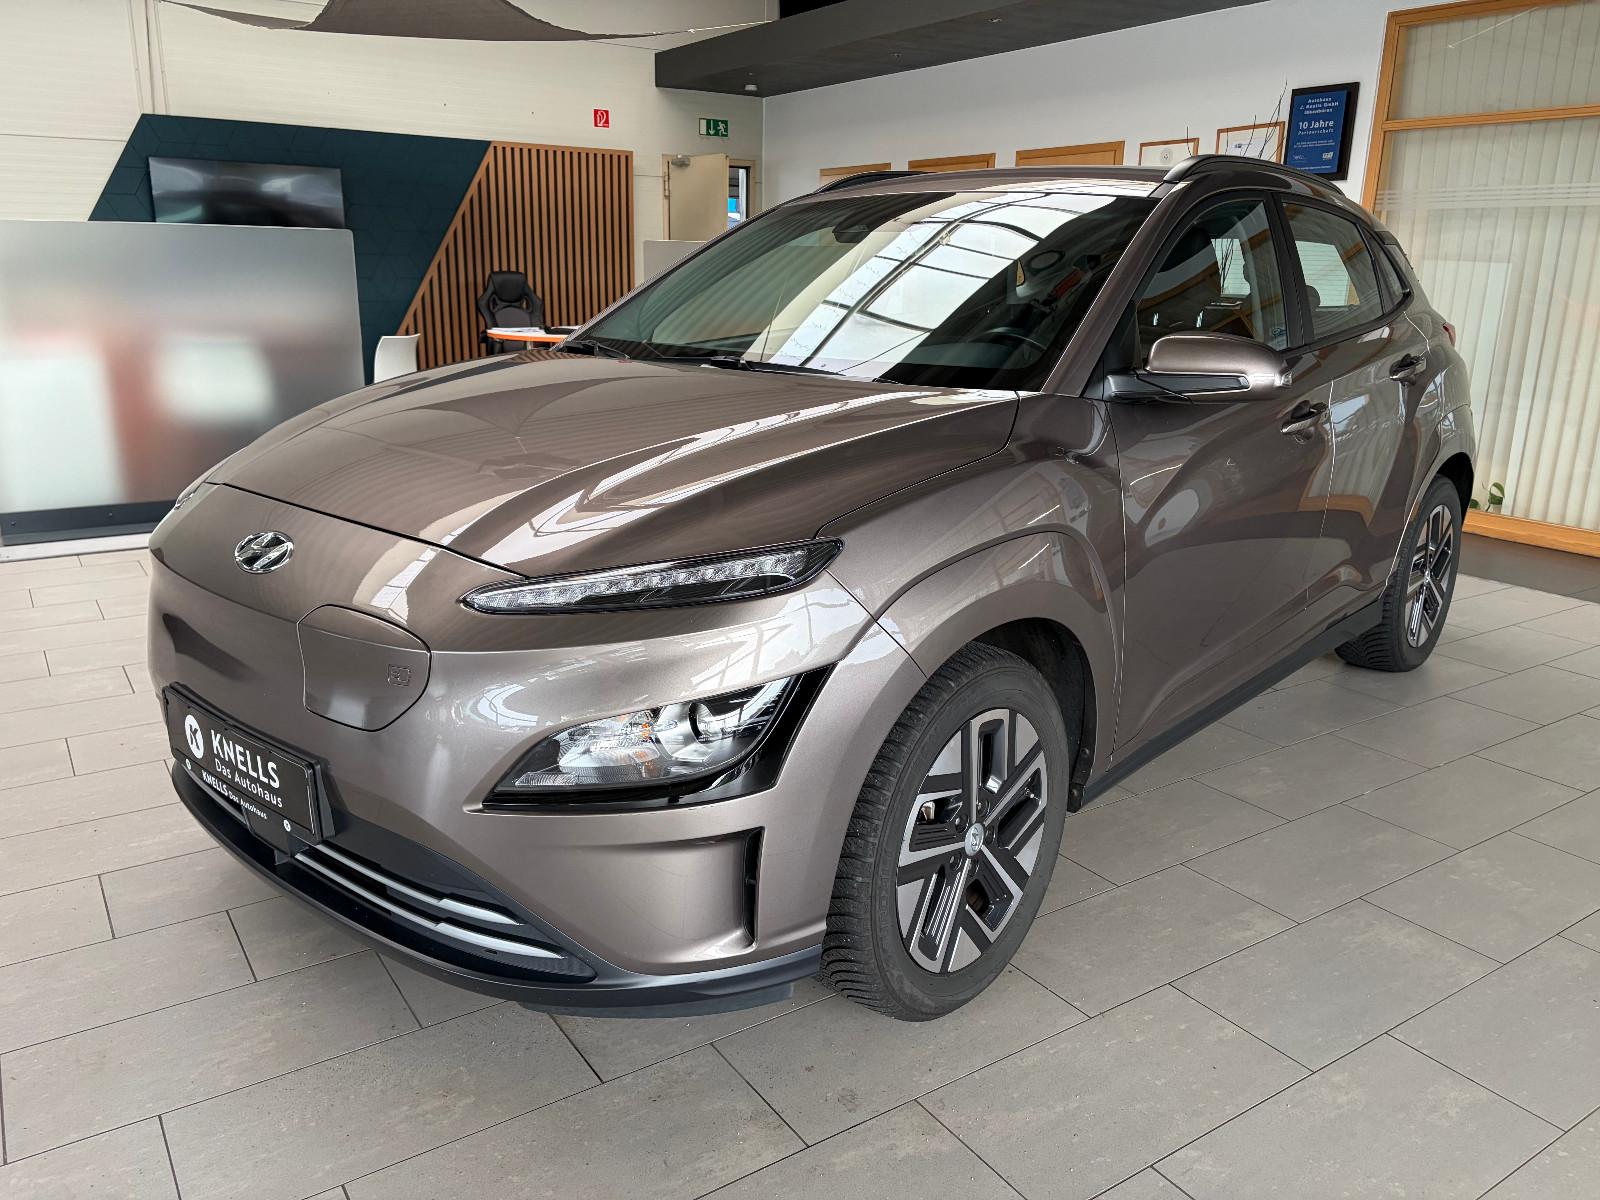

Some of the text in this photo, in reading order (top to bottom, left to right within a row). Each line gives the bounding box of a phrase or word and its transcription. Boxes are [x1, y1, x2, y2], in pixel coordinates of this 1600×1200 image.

[1299, 120, 1334, 130] 10 Jahre
[210, 729, 280, 789] KNELLS
[214, 758, 232, 779] Das
[234, 770, 283, 808] Autohaus
[202, 769, 268, 820] KNELLS Das Autohaus
